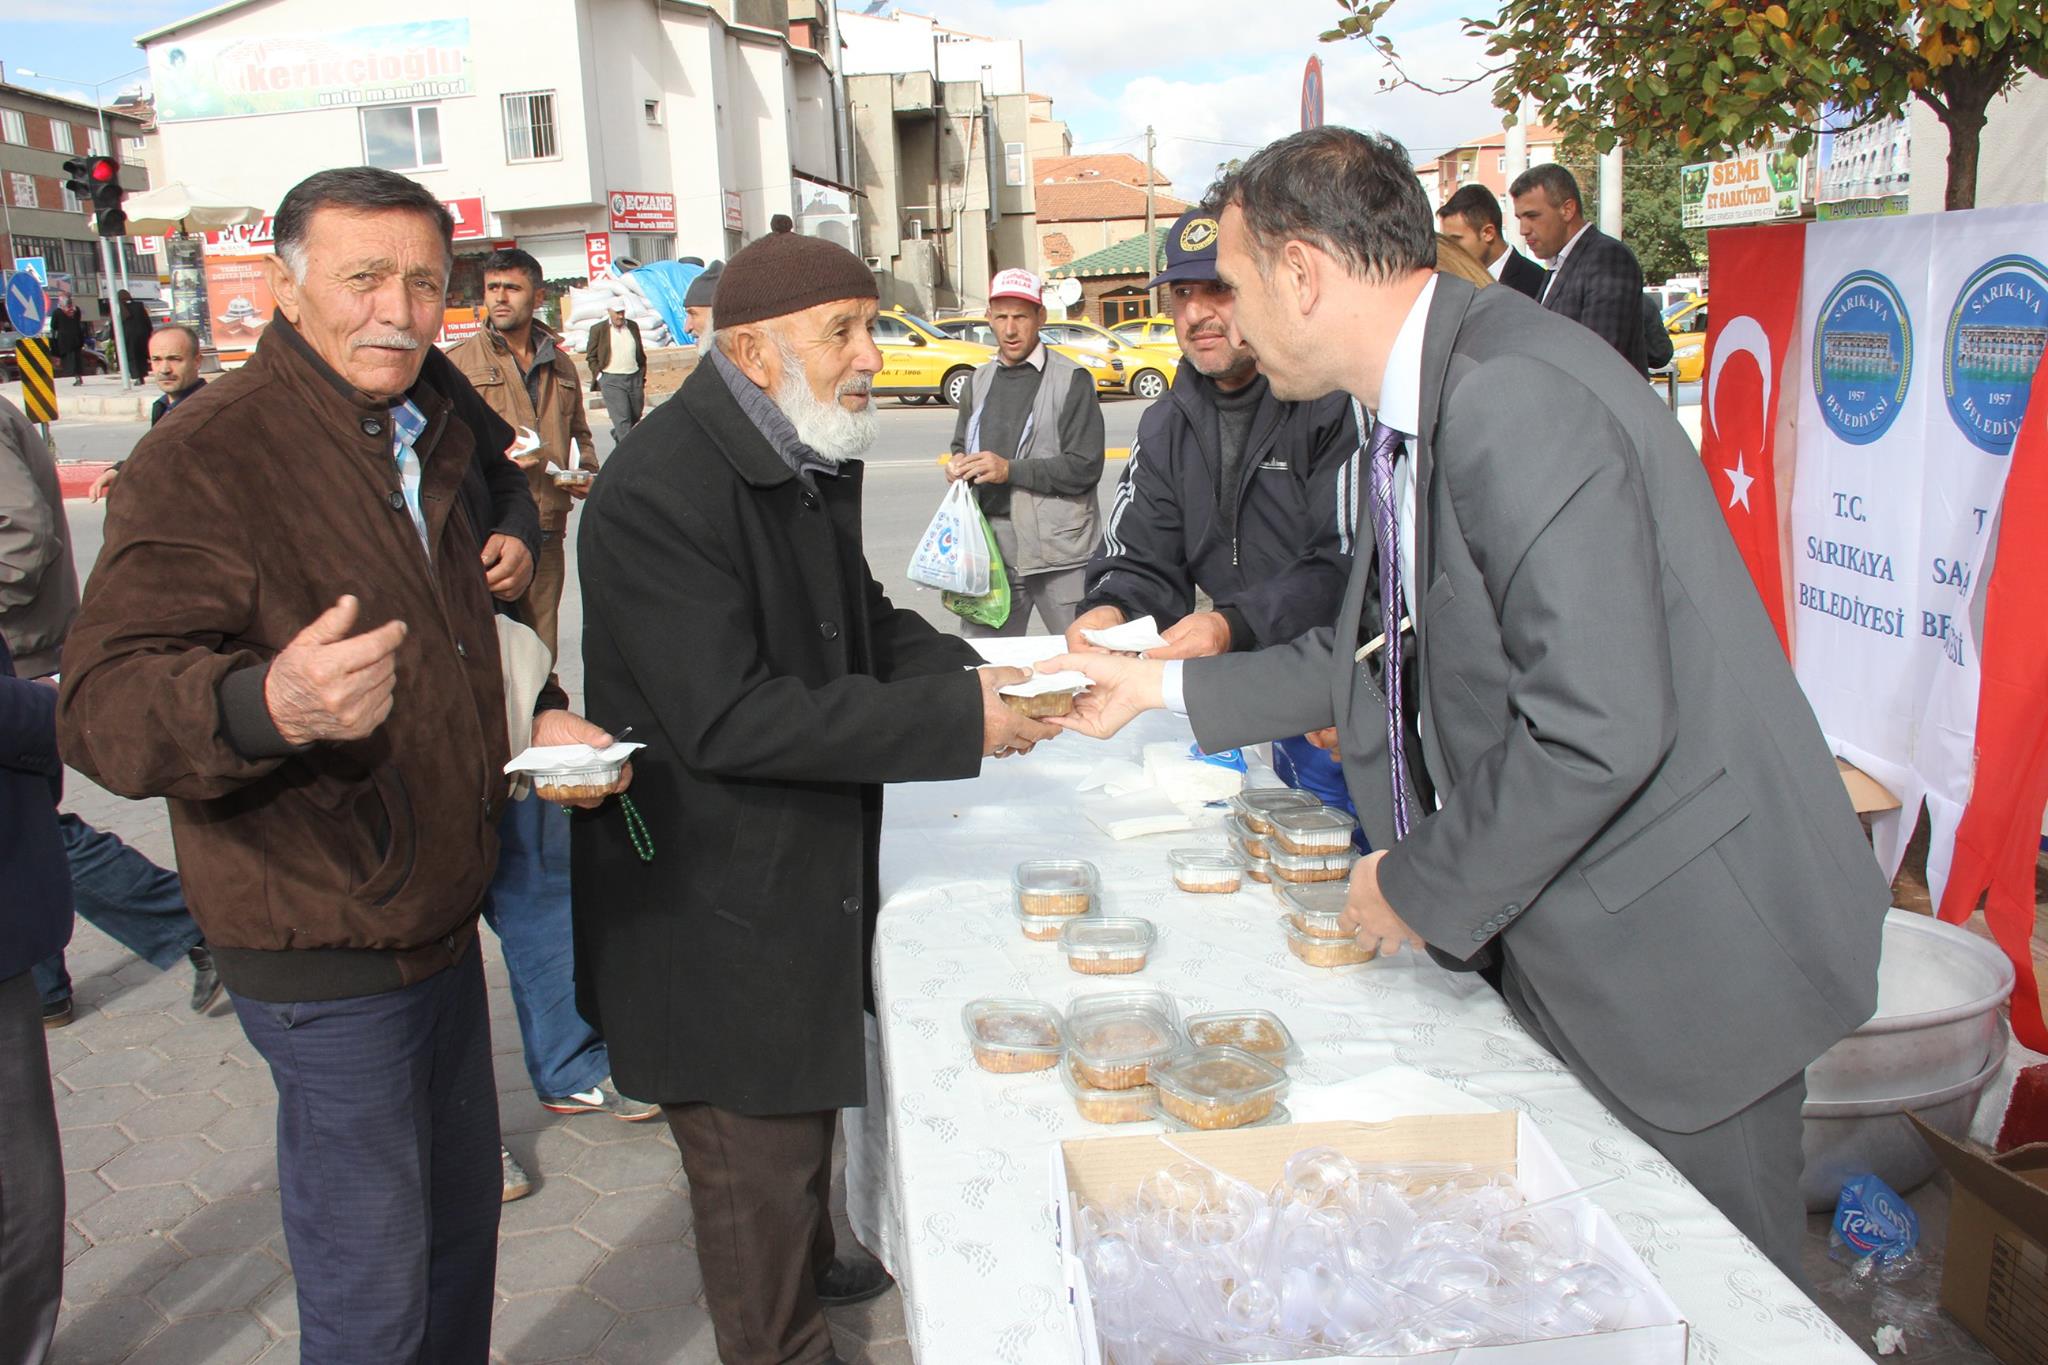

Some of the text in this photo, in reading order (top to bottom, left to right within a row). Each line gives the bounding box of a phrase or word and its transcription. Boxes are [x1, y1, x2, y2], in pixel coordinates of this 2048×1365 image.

[625, 194, 673, 211] ECZANE
[1707, 194, 1717, 209] ET
[1834, 294, 1888, 322] SARIKAYA
[1972, 282, 2041, 315] SARIKAYA
[1848, 391, 1866, 401] 1957
[1988, 393, 2012, 406] 1957
[1826, 394, 1889, 428] BELEDİYESİ
[1832, 492, 1867, 522] T.C.
[1806, 536, 1895, 582] SARIKAYA
[1799, 583, 1905, 638] BELEDİYESİ
